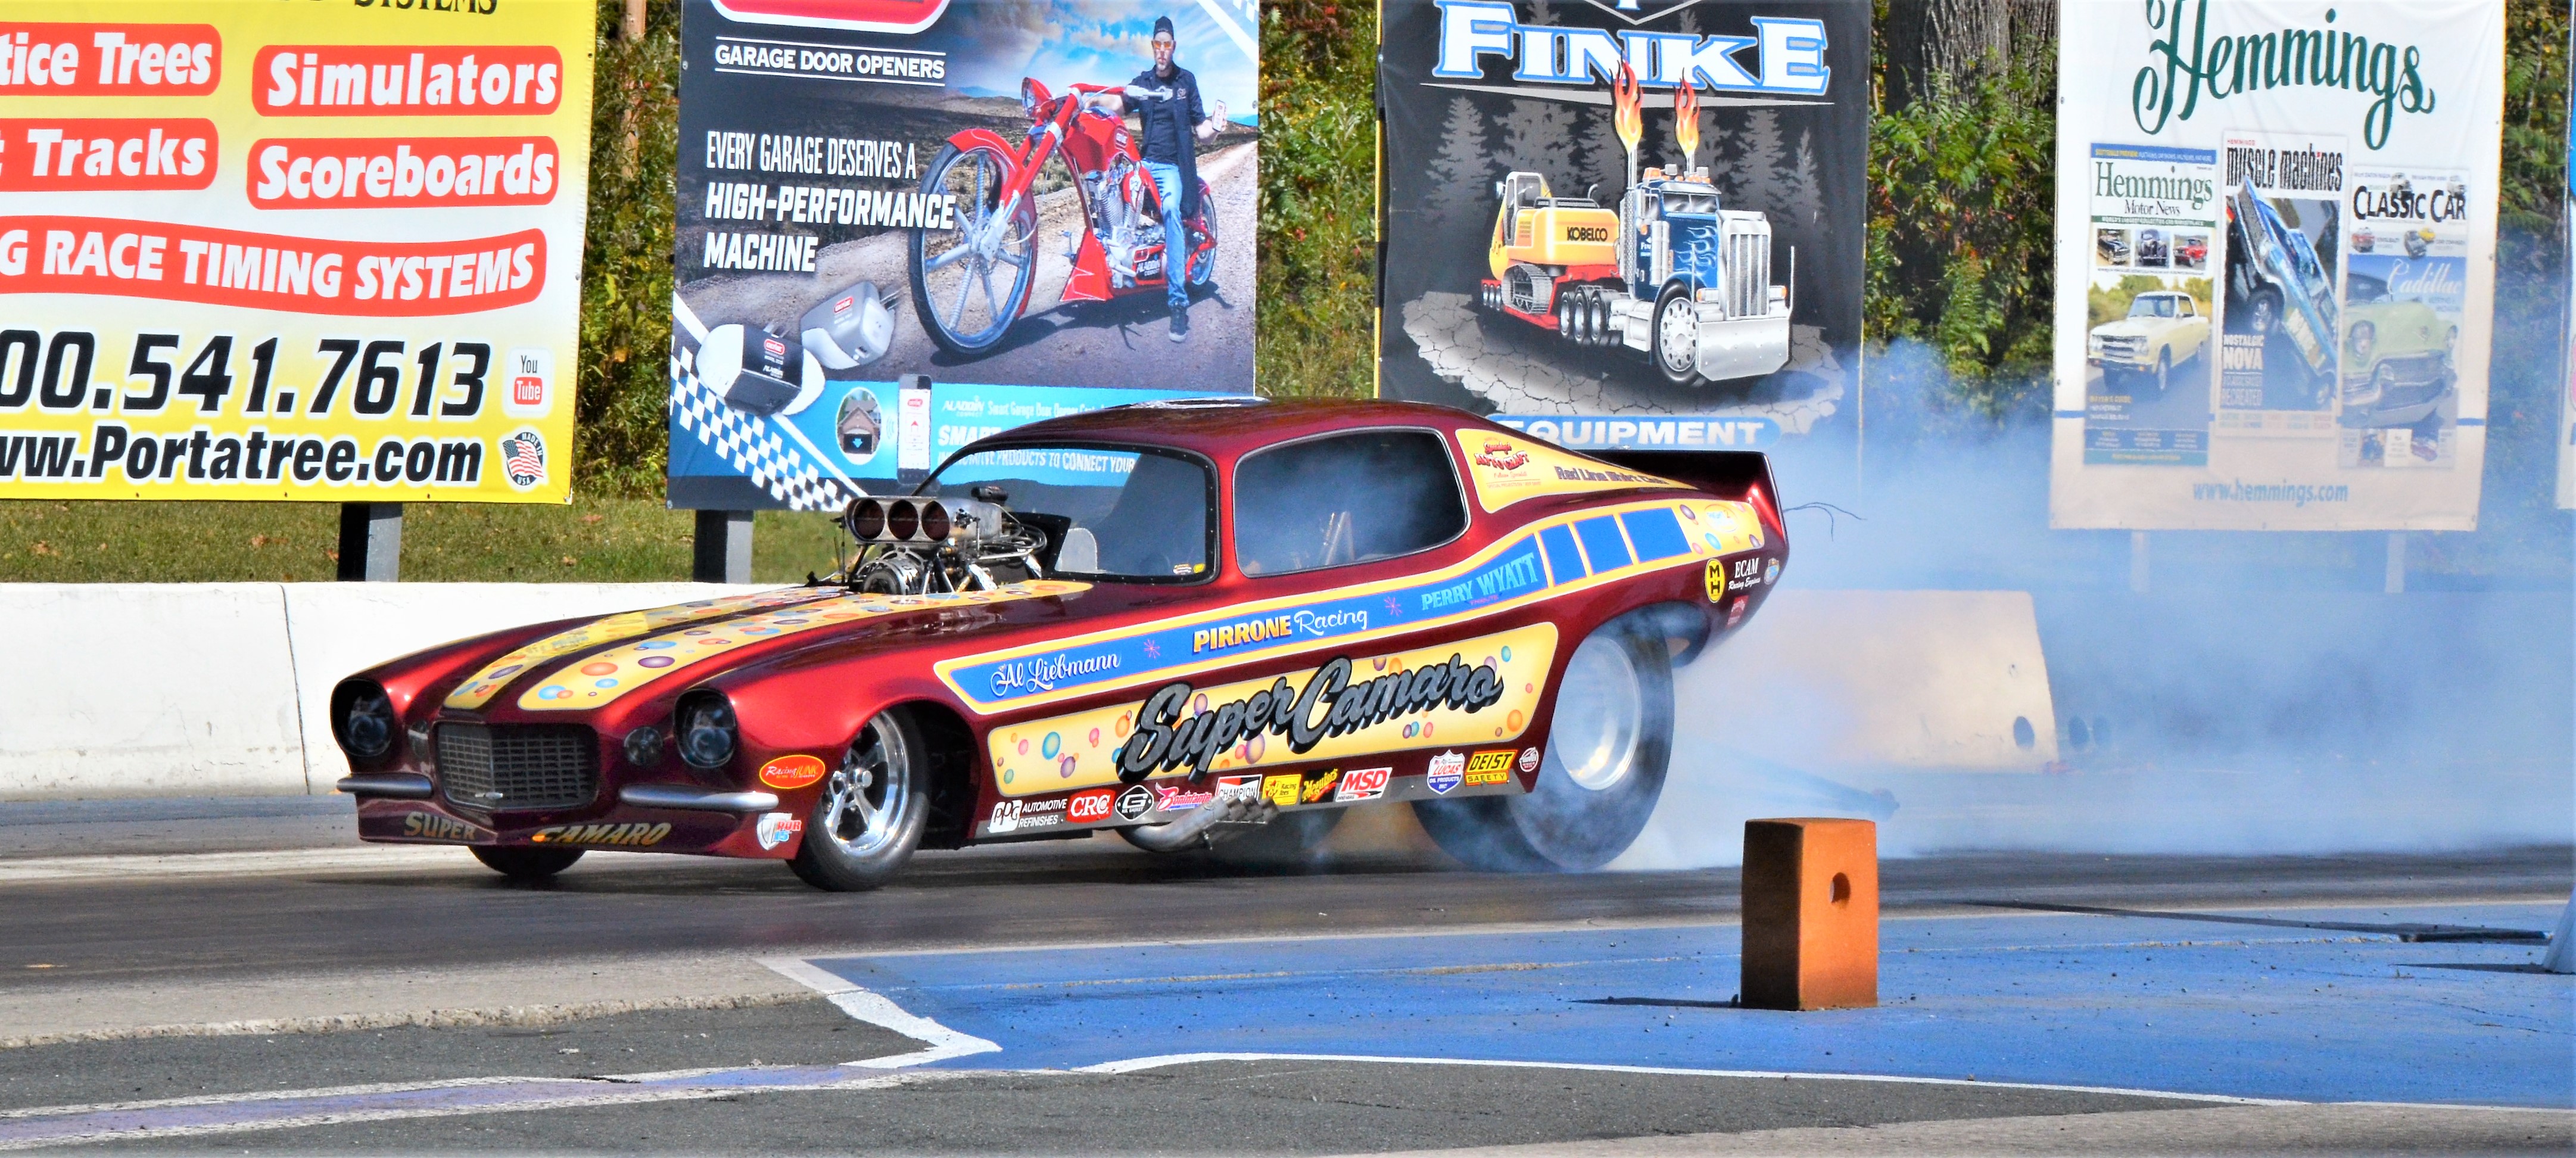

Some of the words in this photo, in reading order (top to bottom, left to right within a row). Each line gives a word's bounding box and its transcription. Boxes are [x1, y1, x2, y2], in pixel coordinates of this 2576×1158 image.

[94, 32, 213, 86] Trees
[1432, 0, 1830, 95] FINKE
[715, 45, 796, 70] GARAGE
[800, 50, 853, 73] DOOR
[856, 55, 945, 79] OPENERS
[267, 52, 557, 107] Simulators
[27, 127, 206, 178] Tracks
[707, 131, 755, 170] EVERY
[760, 134, 823, 175] GARAGE
[827, 139, 902, 179] DESERVES
[905, 143, 917, 179] A
[257, 144, 554, 200] Scoreboards
[2280, 143, 2343, 191] machines
[2095, 161, 2212, 210] Hemmings
[705, 182, 956, 230] HIGH-PERFORMANCE
[2125, 200, 2153, 215] Motor
[2156, 201, 2180, 216] News
[2354, 185, 2427, 220] CLASSIC
[2430, 189, 2466, 223] CAR
[1566, 226, 1608, 242] KOBELCO
[703, 232, 818, 272] MACHINE
[42, 230, 167, 281] RACE
[179, 243, 342, 298] TIMING
[355, 243, 534, 300] SYSTEMS
[2387, 259, 2462, 295] Cadillac
[521, 355, 537, 373] You
[2223, 347, 2263, 370] NOVA
[516, 381, 540, 400] Tube
[1011, 401, 1034, 419] Garage
[1036, 402, 1051, 416] Door
[522, 432, 538, 447] MADE
[1494, 419, 1764, 446] QUIPMENT
[997, 450, 1046, 466] PRODUCTS
[1049, 452, 1060, 468] TO
[1063, 453, 1108, 472] CONNECT
[1554, 466, 1580, 480] Red
[517, 477, 530, 485] USA
[2193, 479, 2348, 508] www.hemmings.com
[1734, 558, 1759, 578] ECAM
[1422, 580, 1473, 611] PERRY
[1475, 552, 1538, 596] WYATT
[1728, 580, 1744, 591] Racing
[990, 663, 1024, 696] Al
[1028, 651, 1122, 690] Liebmann
[1194, 615, 1291, 653] PIRRONE
[1293, 609, 1368, 636] Racing
[1115, 681, 1297, 783] Super
[1286, 653, 1504, 754] Camaro
[1433, 764, 1461, 776] LUCAS
[1469, 754, 1512, 771] DEIST
[1341, 770, 1387, 792] MSD
[1468, 773, 1506, 782] SAFETY
[1022, 799, 1068, 813] AUTOMOTIVE
[1071, 795, 1110, 817] CRC
[1220, 786, 1258, 801] CHAMPION
[404, 811, 476, 841] SUPER
[534, 823, 672, 846] CAMARO
[1018, 815, 1058, 827] REFINISHES
